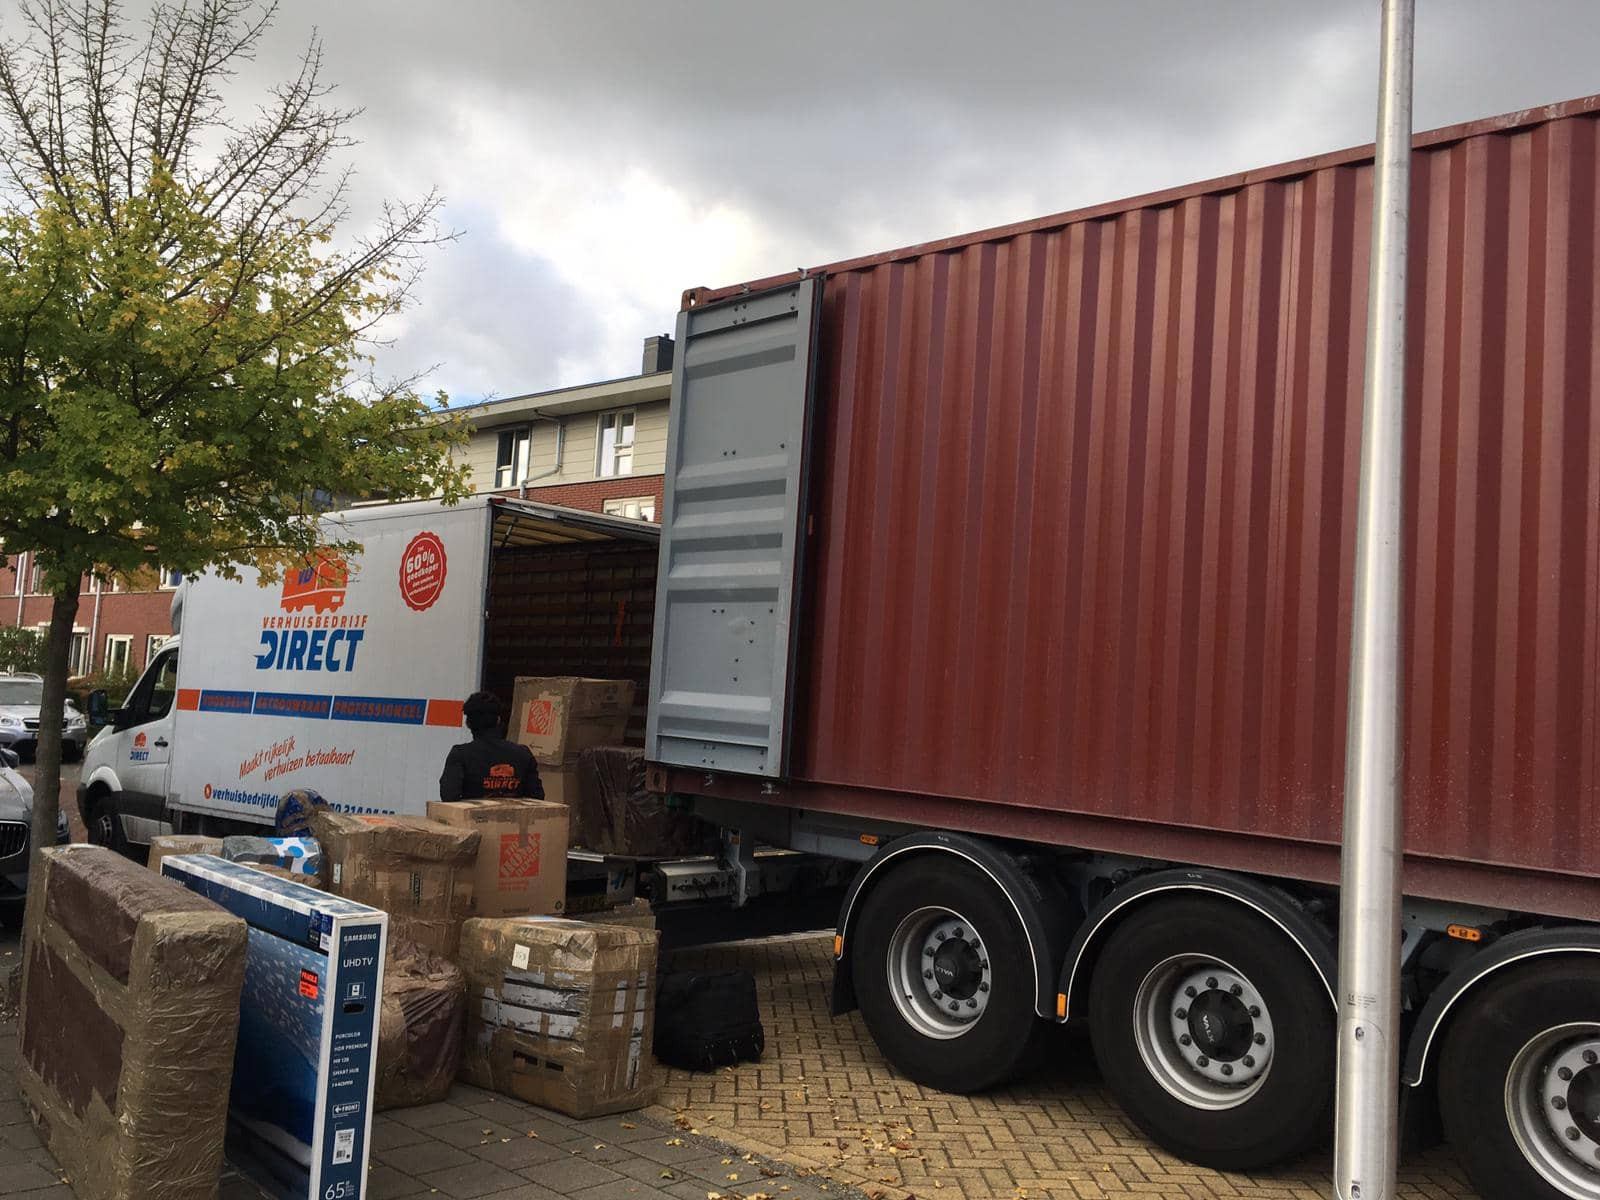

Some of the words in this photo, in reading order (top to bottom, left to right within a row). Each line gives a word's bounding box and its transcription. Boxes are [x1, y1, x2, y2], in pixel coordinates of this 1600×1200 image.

[406, 548, 435, 574] 60%
[262, 614, 368, 629] VERHUISBEDRIJF
[254, 628, 365, 673] DIRECT
[239, 749, 265, 780] Maakt
[264, 735, 296, 765] rijkelijk
[264, 757, 304, 782] verhuizen
[305, 746, 356, 769] betaalbaar!
[343, 933, 377, 943] SAMSUNG
[343, 958, 361, 968] UHD
[362, 957, 373, 966] TV
[325, 1181, 345, 1200] 65
